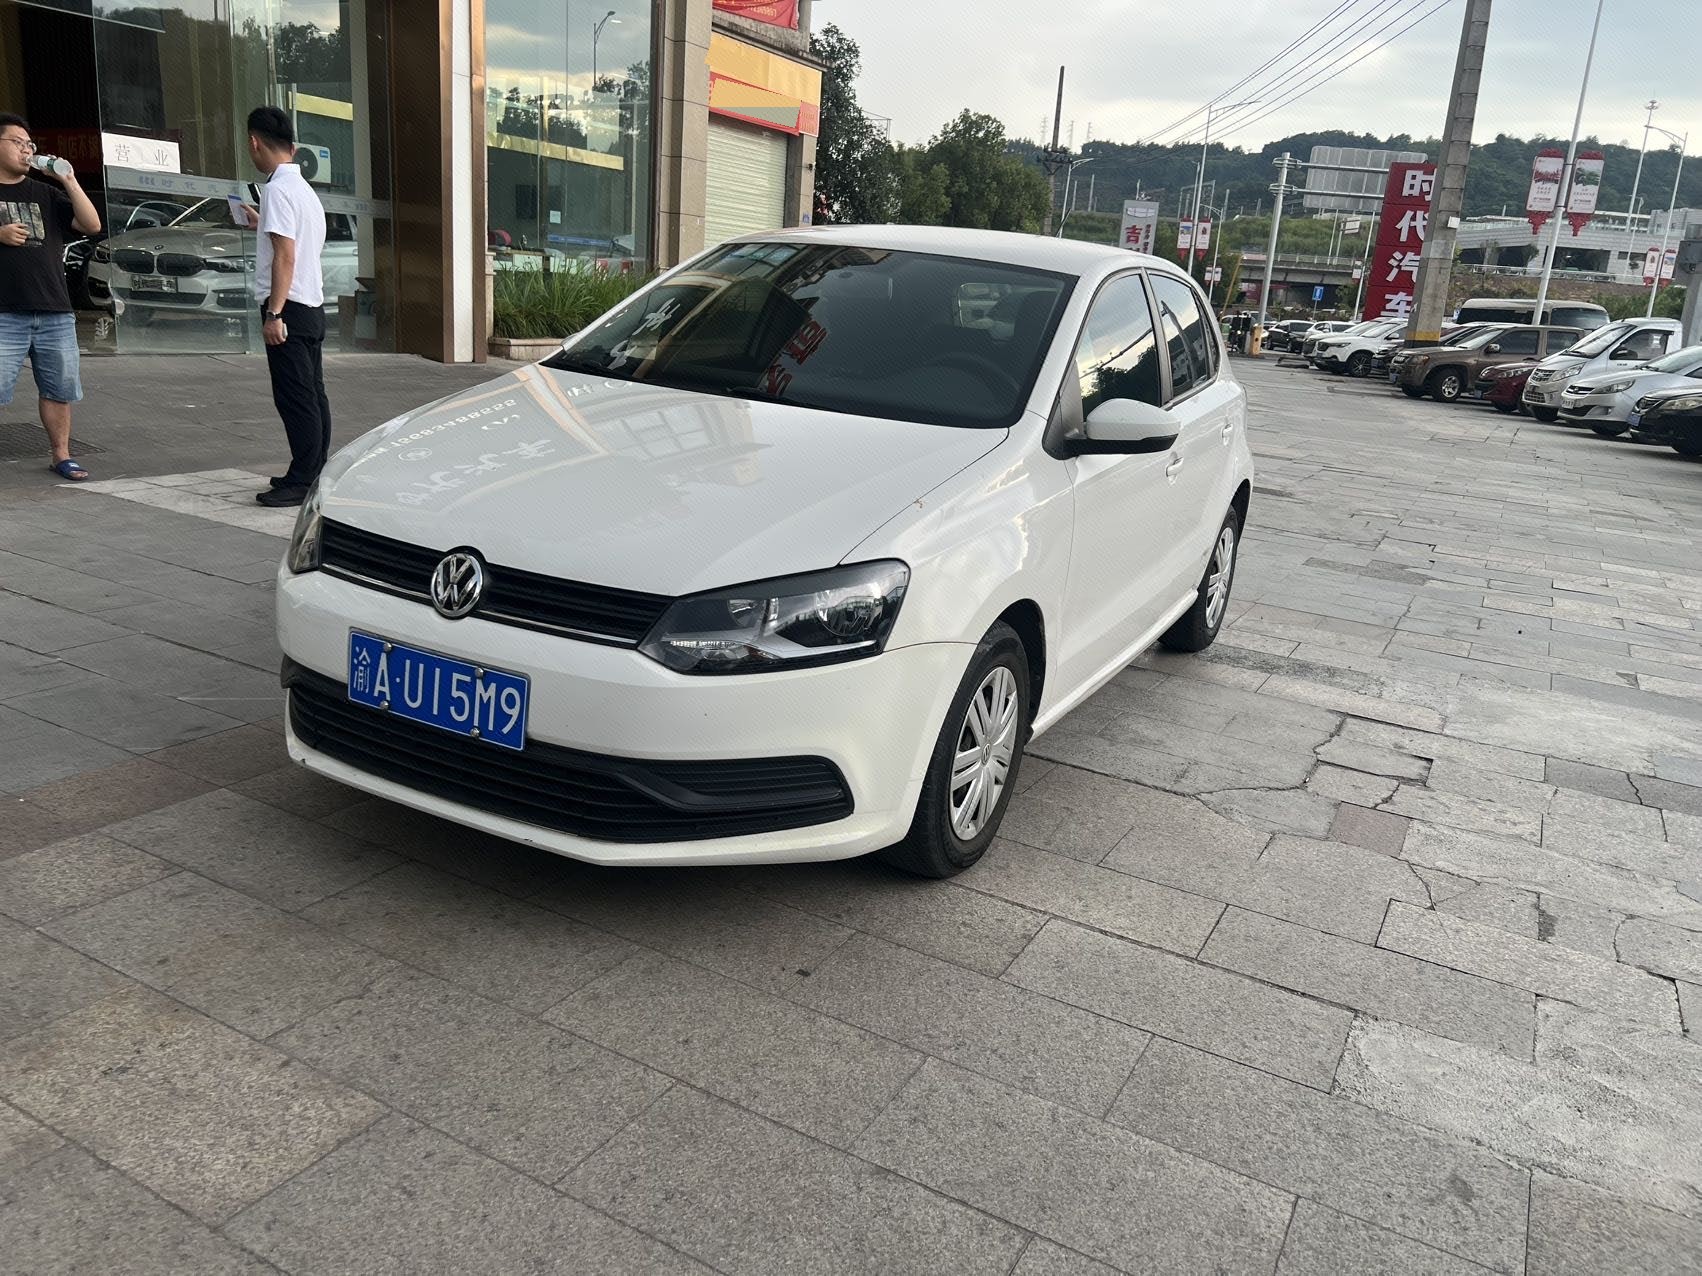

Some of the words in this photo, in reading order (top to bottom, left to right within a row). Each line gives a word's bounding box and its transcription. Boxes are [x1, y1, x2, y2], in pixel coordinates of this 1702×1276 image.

[115, 144, 168, 166] 营业
[1380, 168, 1437, 318] 时代汽车
